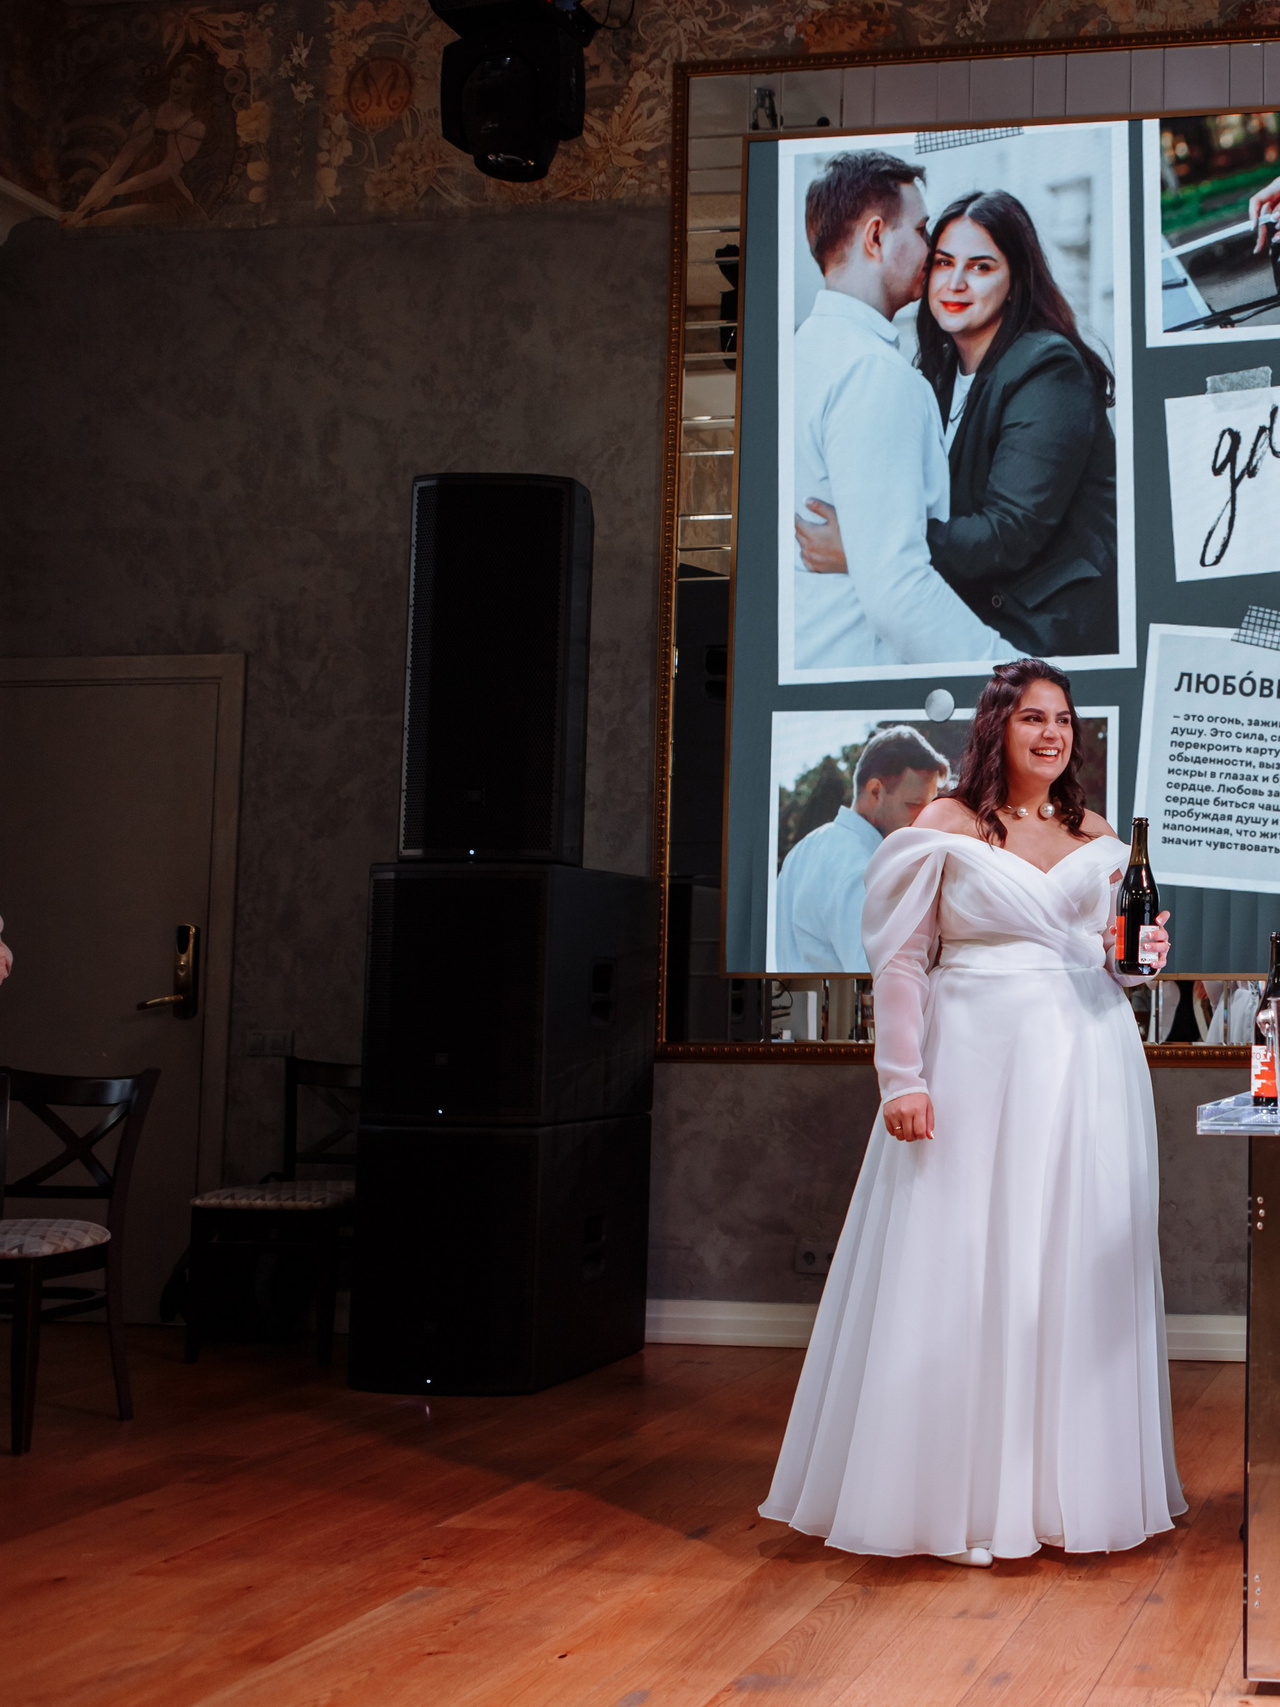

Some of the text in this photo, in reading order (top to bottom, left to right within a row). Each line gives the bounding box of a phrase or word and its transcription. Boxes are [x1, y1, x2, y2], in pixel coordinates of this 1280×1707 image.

[1183, 714, 1205, 723] это
[1207, 715, 1245, 727] огонь,
[1170, 726, 1207, 739] душу.
[1210, 728, 1233, 739] Это
[1235, 731, 1268, 743] сила,
[1170, 740, 1243, 754] перекроить
[1169, 753, 1256, 770] обыденности,
[1167, 768, 1208, 780] искры
[1210, 771, 1217, 779] в
[1219, 772, 1259, 783] глазах
[1262, 776, 1270, 784] и
[1166, 781, 1215, 794] сердце.
[1217, 784, 1265, 797] Любовь
[1165, 795, 1211, 807] сердце
[1213, 796, 1256, 810] биться
[1164, 808, 1280, 828] пробуждая душу и
[1162, 823, 1233, 837] напоминая,
[1236, 829, 1257, 838] что
[1161, 836, 1280, 855] значит чувствовать
